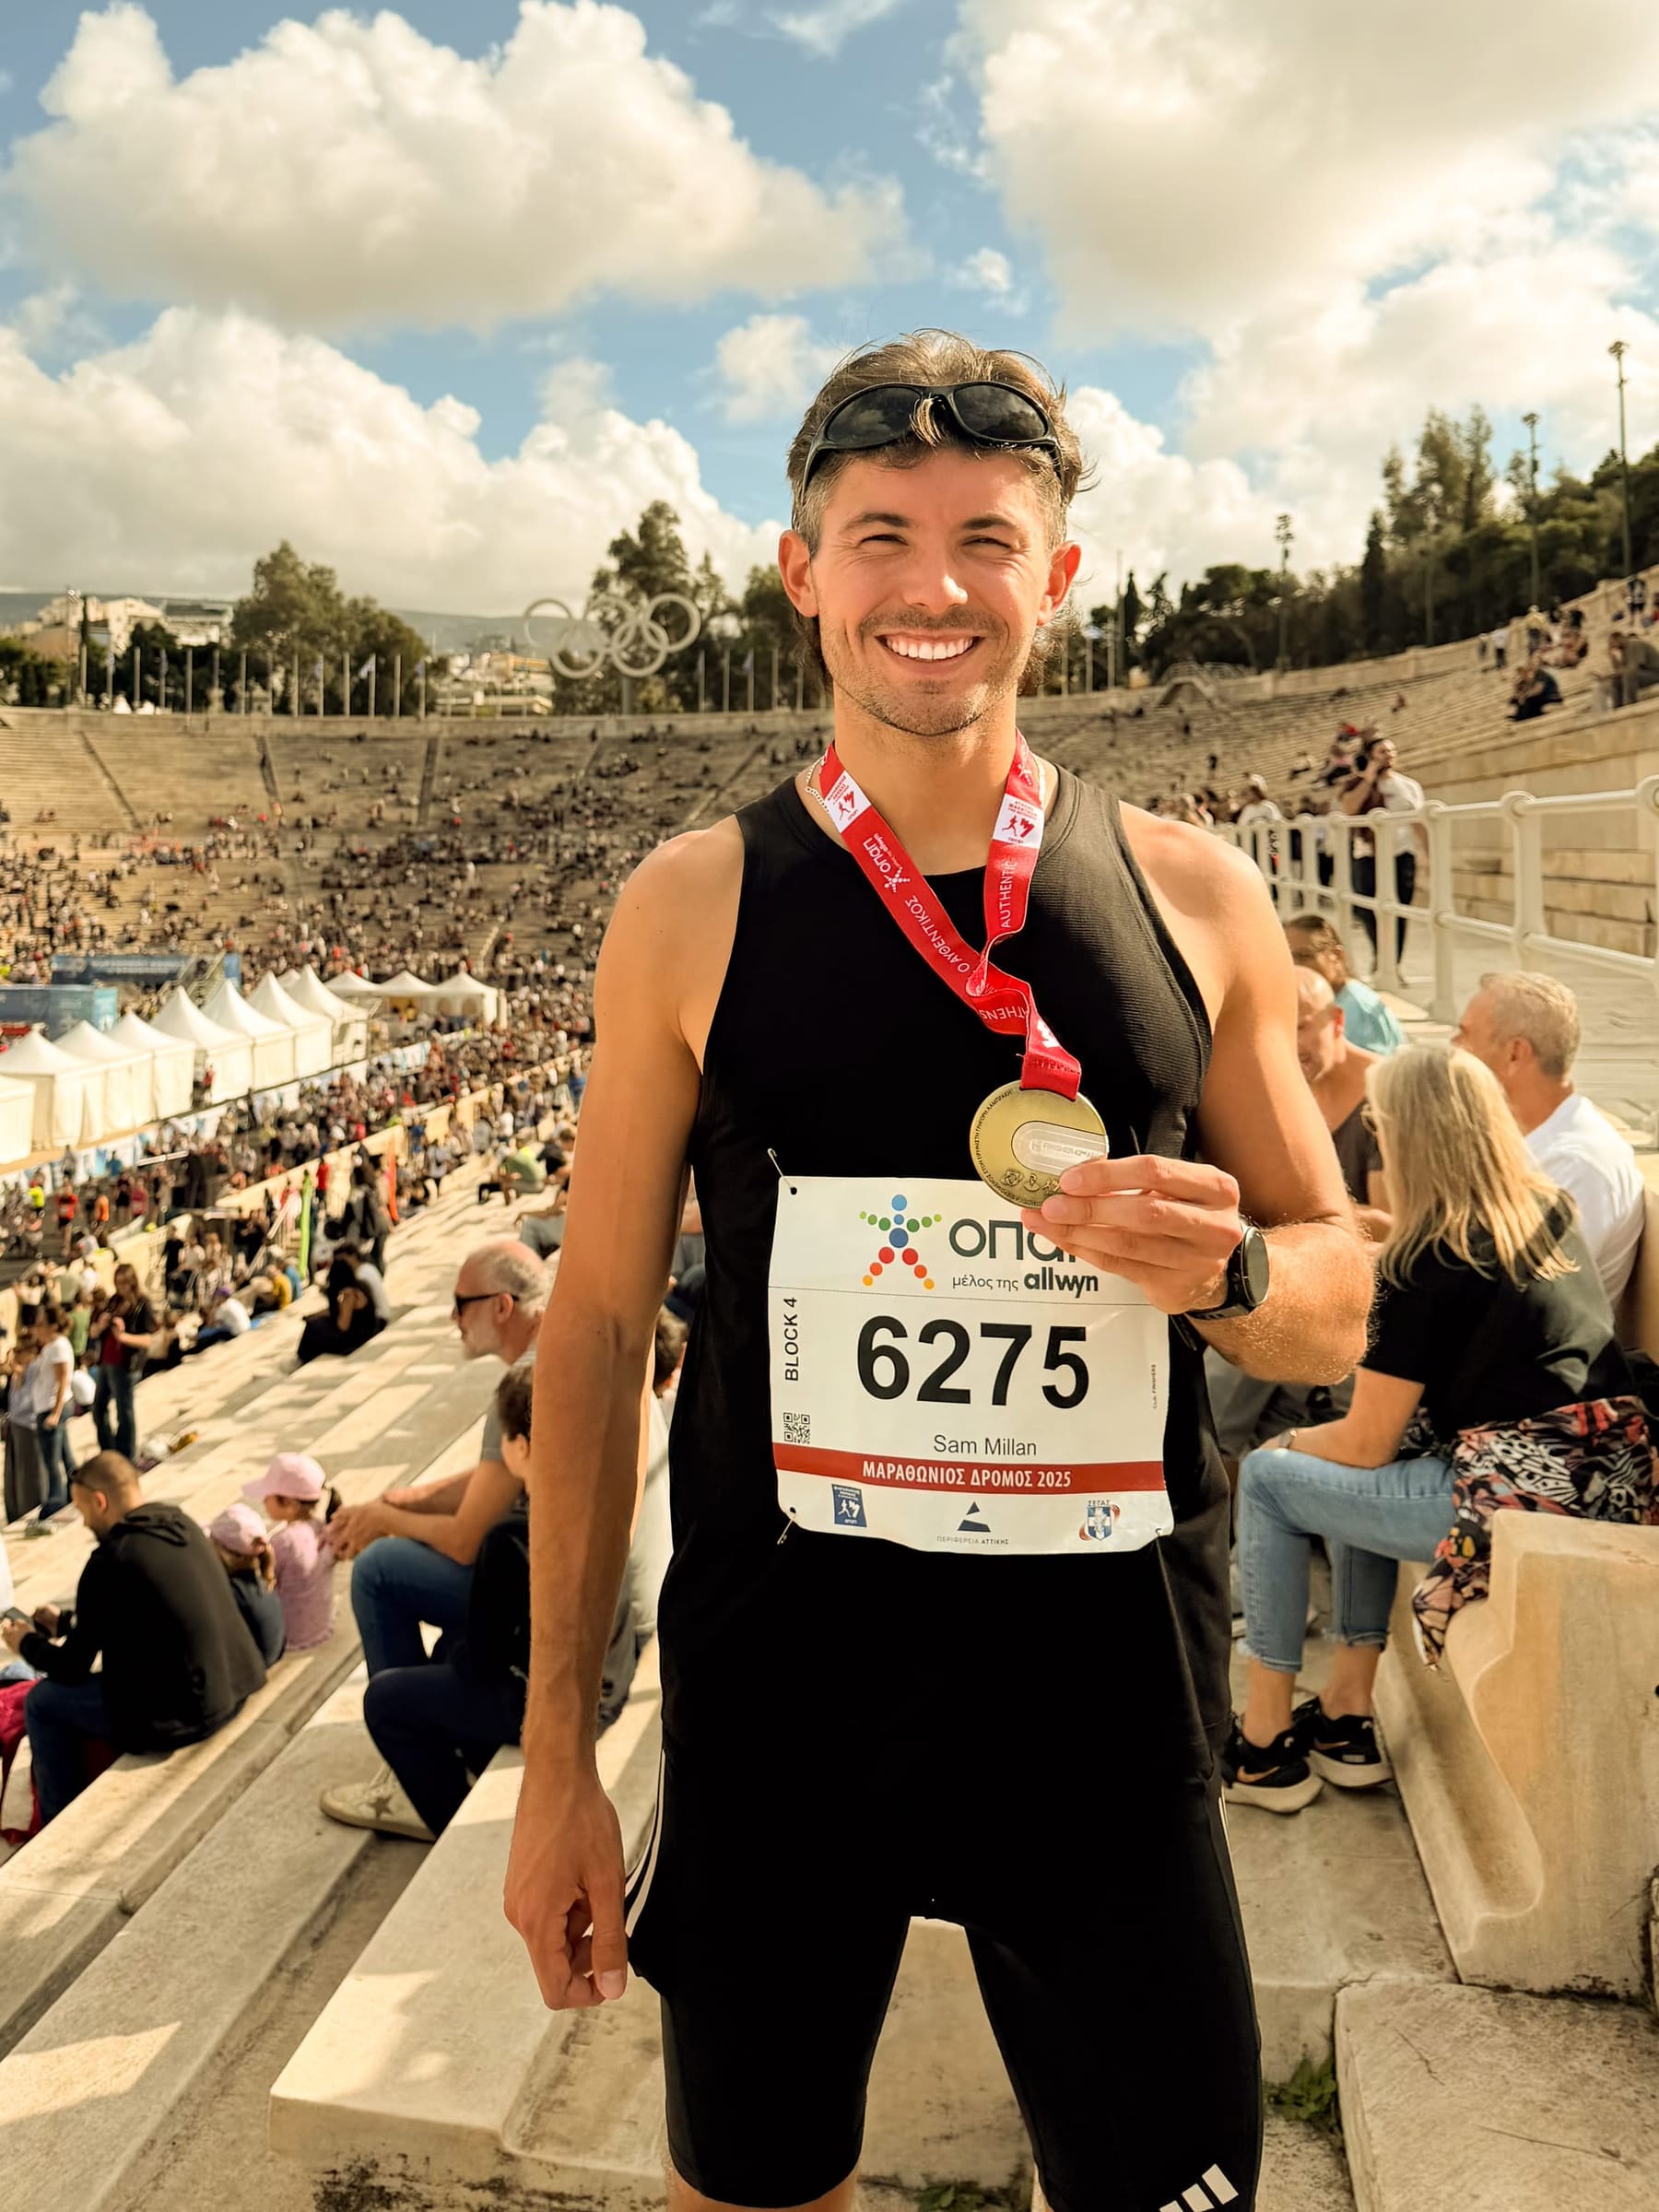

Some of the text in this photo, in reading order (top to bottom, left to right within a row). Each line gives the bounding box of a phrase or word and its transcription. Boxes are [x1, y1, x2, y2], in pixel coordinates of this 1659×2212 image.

[904, 895, 971, 972] Ο ΑΥΘΕΝΤΙΚΟΣ
[952, 1266, 1099, 1299] μέλος της allwyn
[783, 1297, 799, 1382] BLOCK 4
[857, 1315, 1089, 1409] 6275
[934, 1434, 1037, 1456] Sam Millan
[863, 1460, 1071, 1488] ΜΑΡΑΘΩΝΙΟΣ ΔΡΟΜΟΣ 2025
[936, 1535, 980, 1545] ΠΕΡΙΦΕΡΕΙΑ
